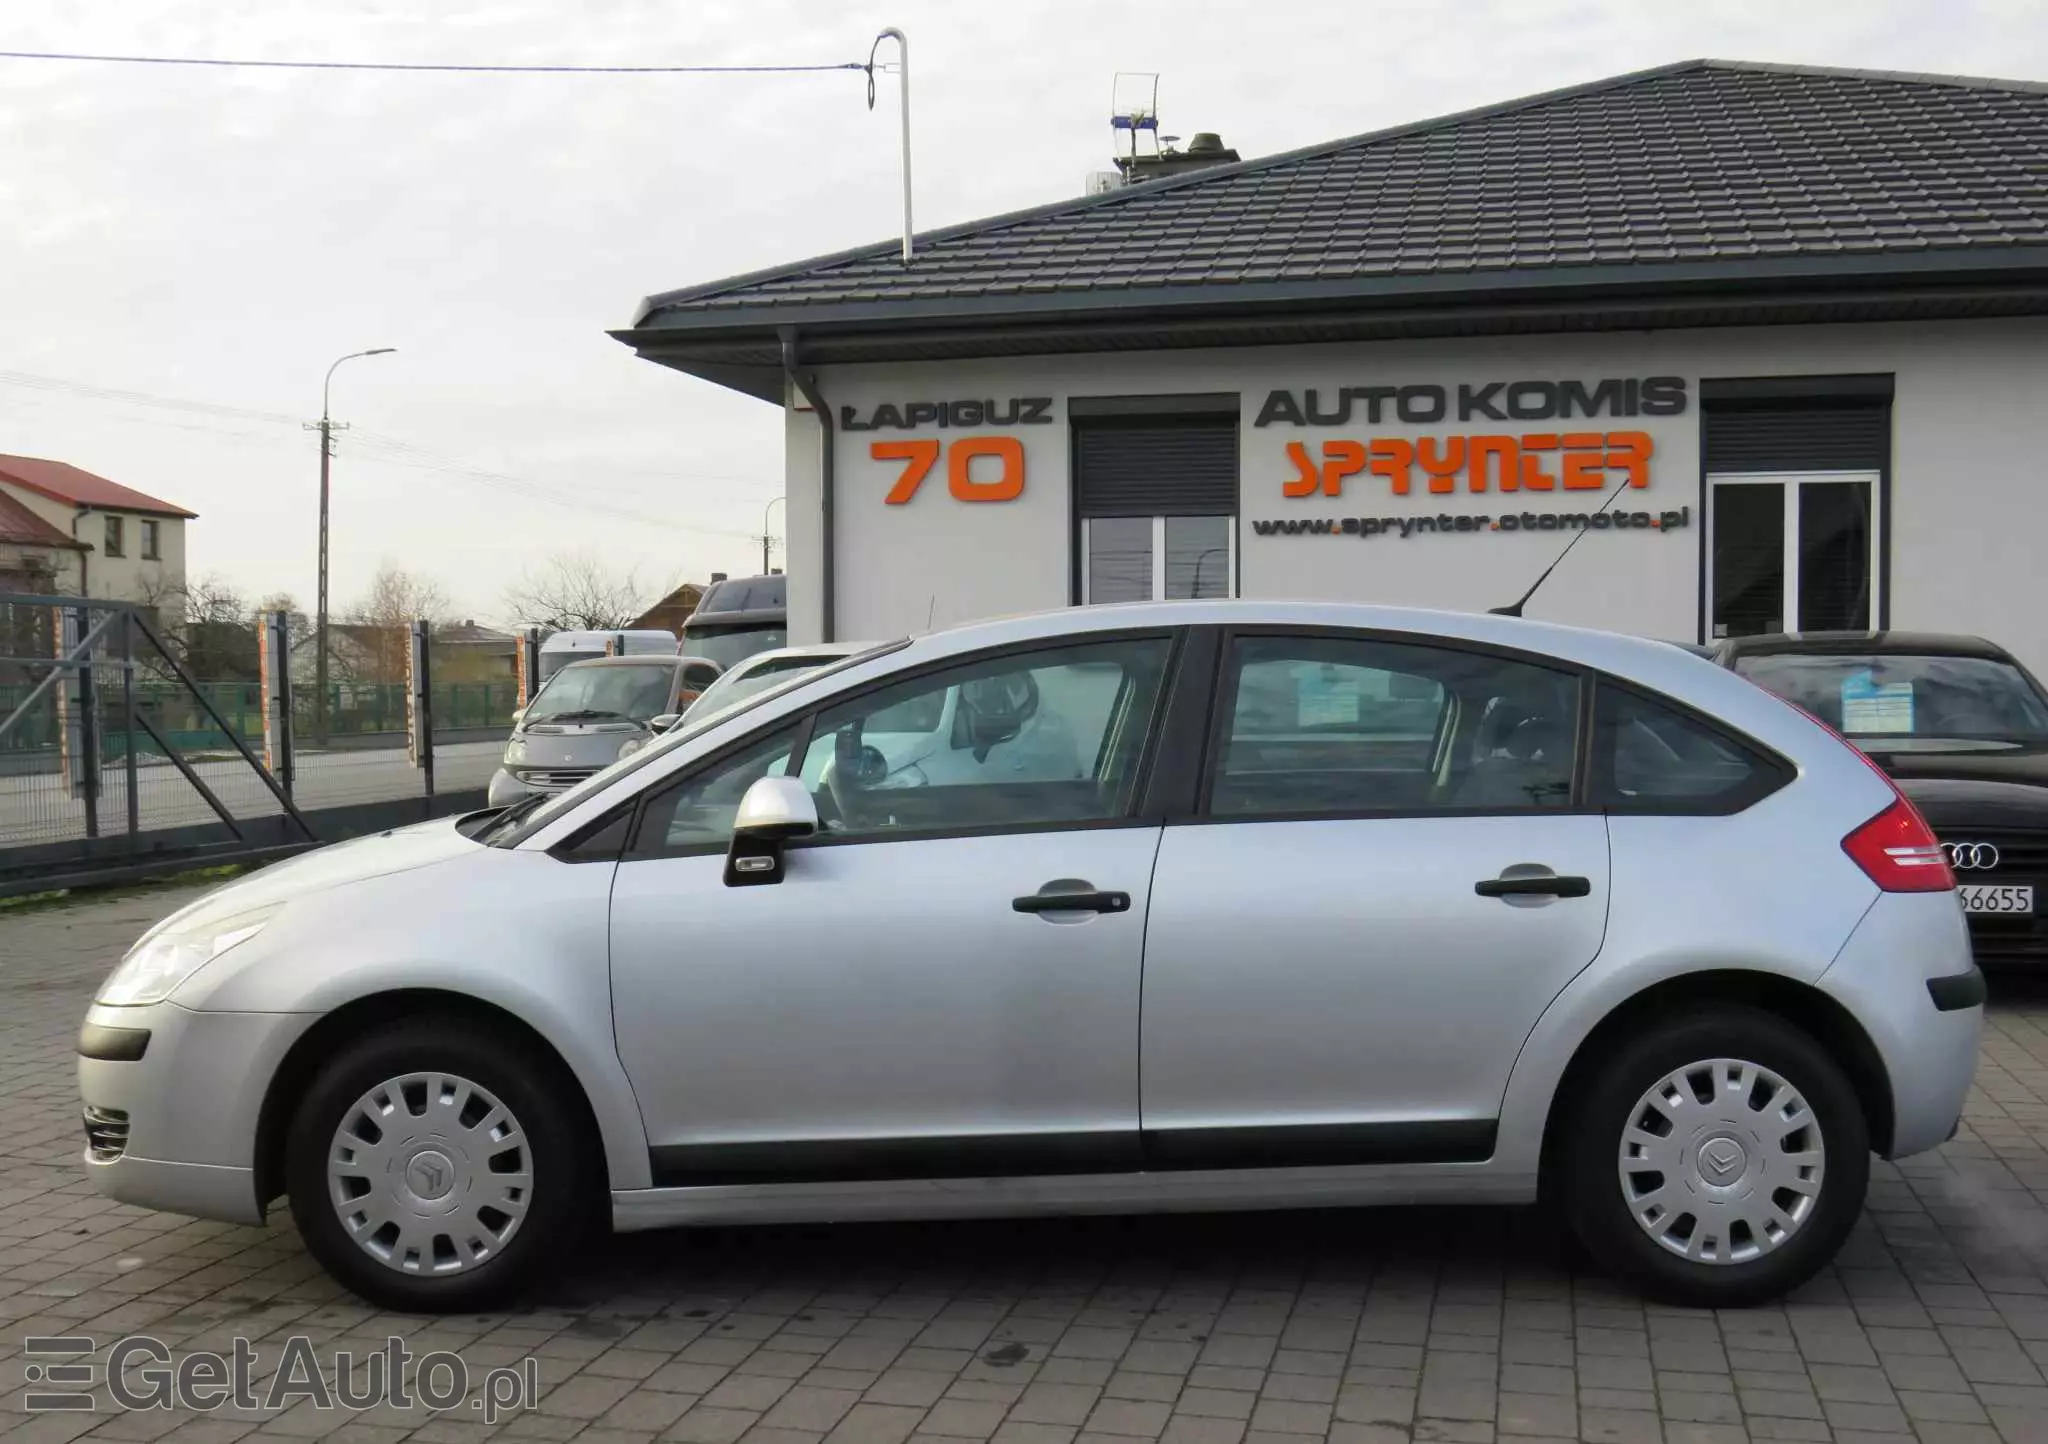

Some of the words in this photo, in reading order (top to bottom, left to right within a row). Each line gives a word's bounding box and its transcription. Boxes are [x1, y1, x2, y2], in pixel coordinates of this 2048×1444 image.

[841, 397, 1054, 431] ŁAPIGUZ
[1254, 384, 1446, 428] AUTO
[1457, 376, 1687, 422] KOMIS
[869, 436, 1025, 505] 70
[1282, 430, 1655, 499] SPRYNTER
[1252, 506, 1690, 538] www.sprynter.otomoto.pl
